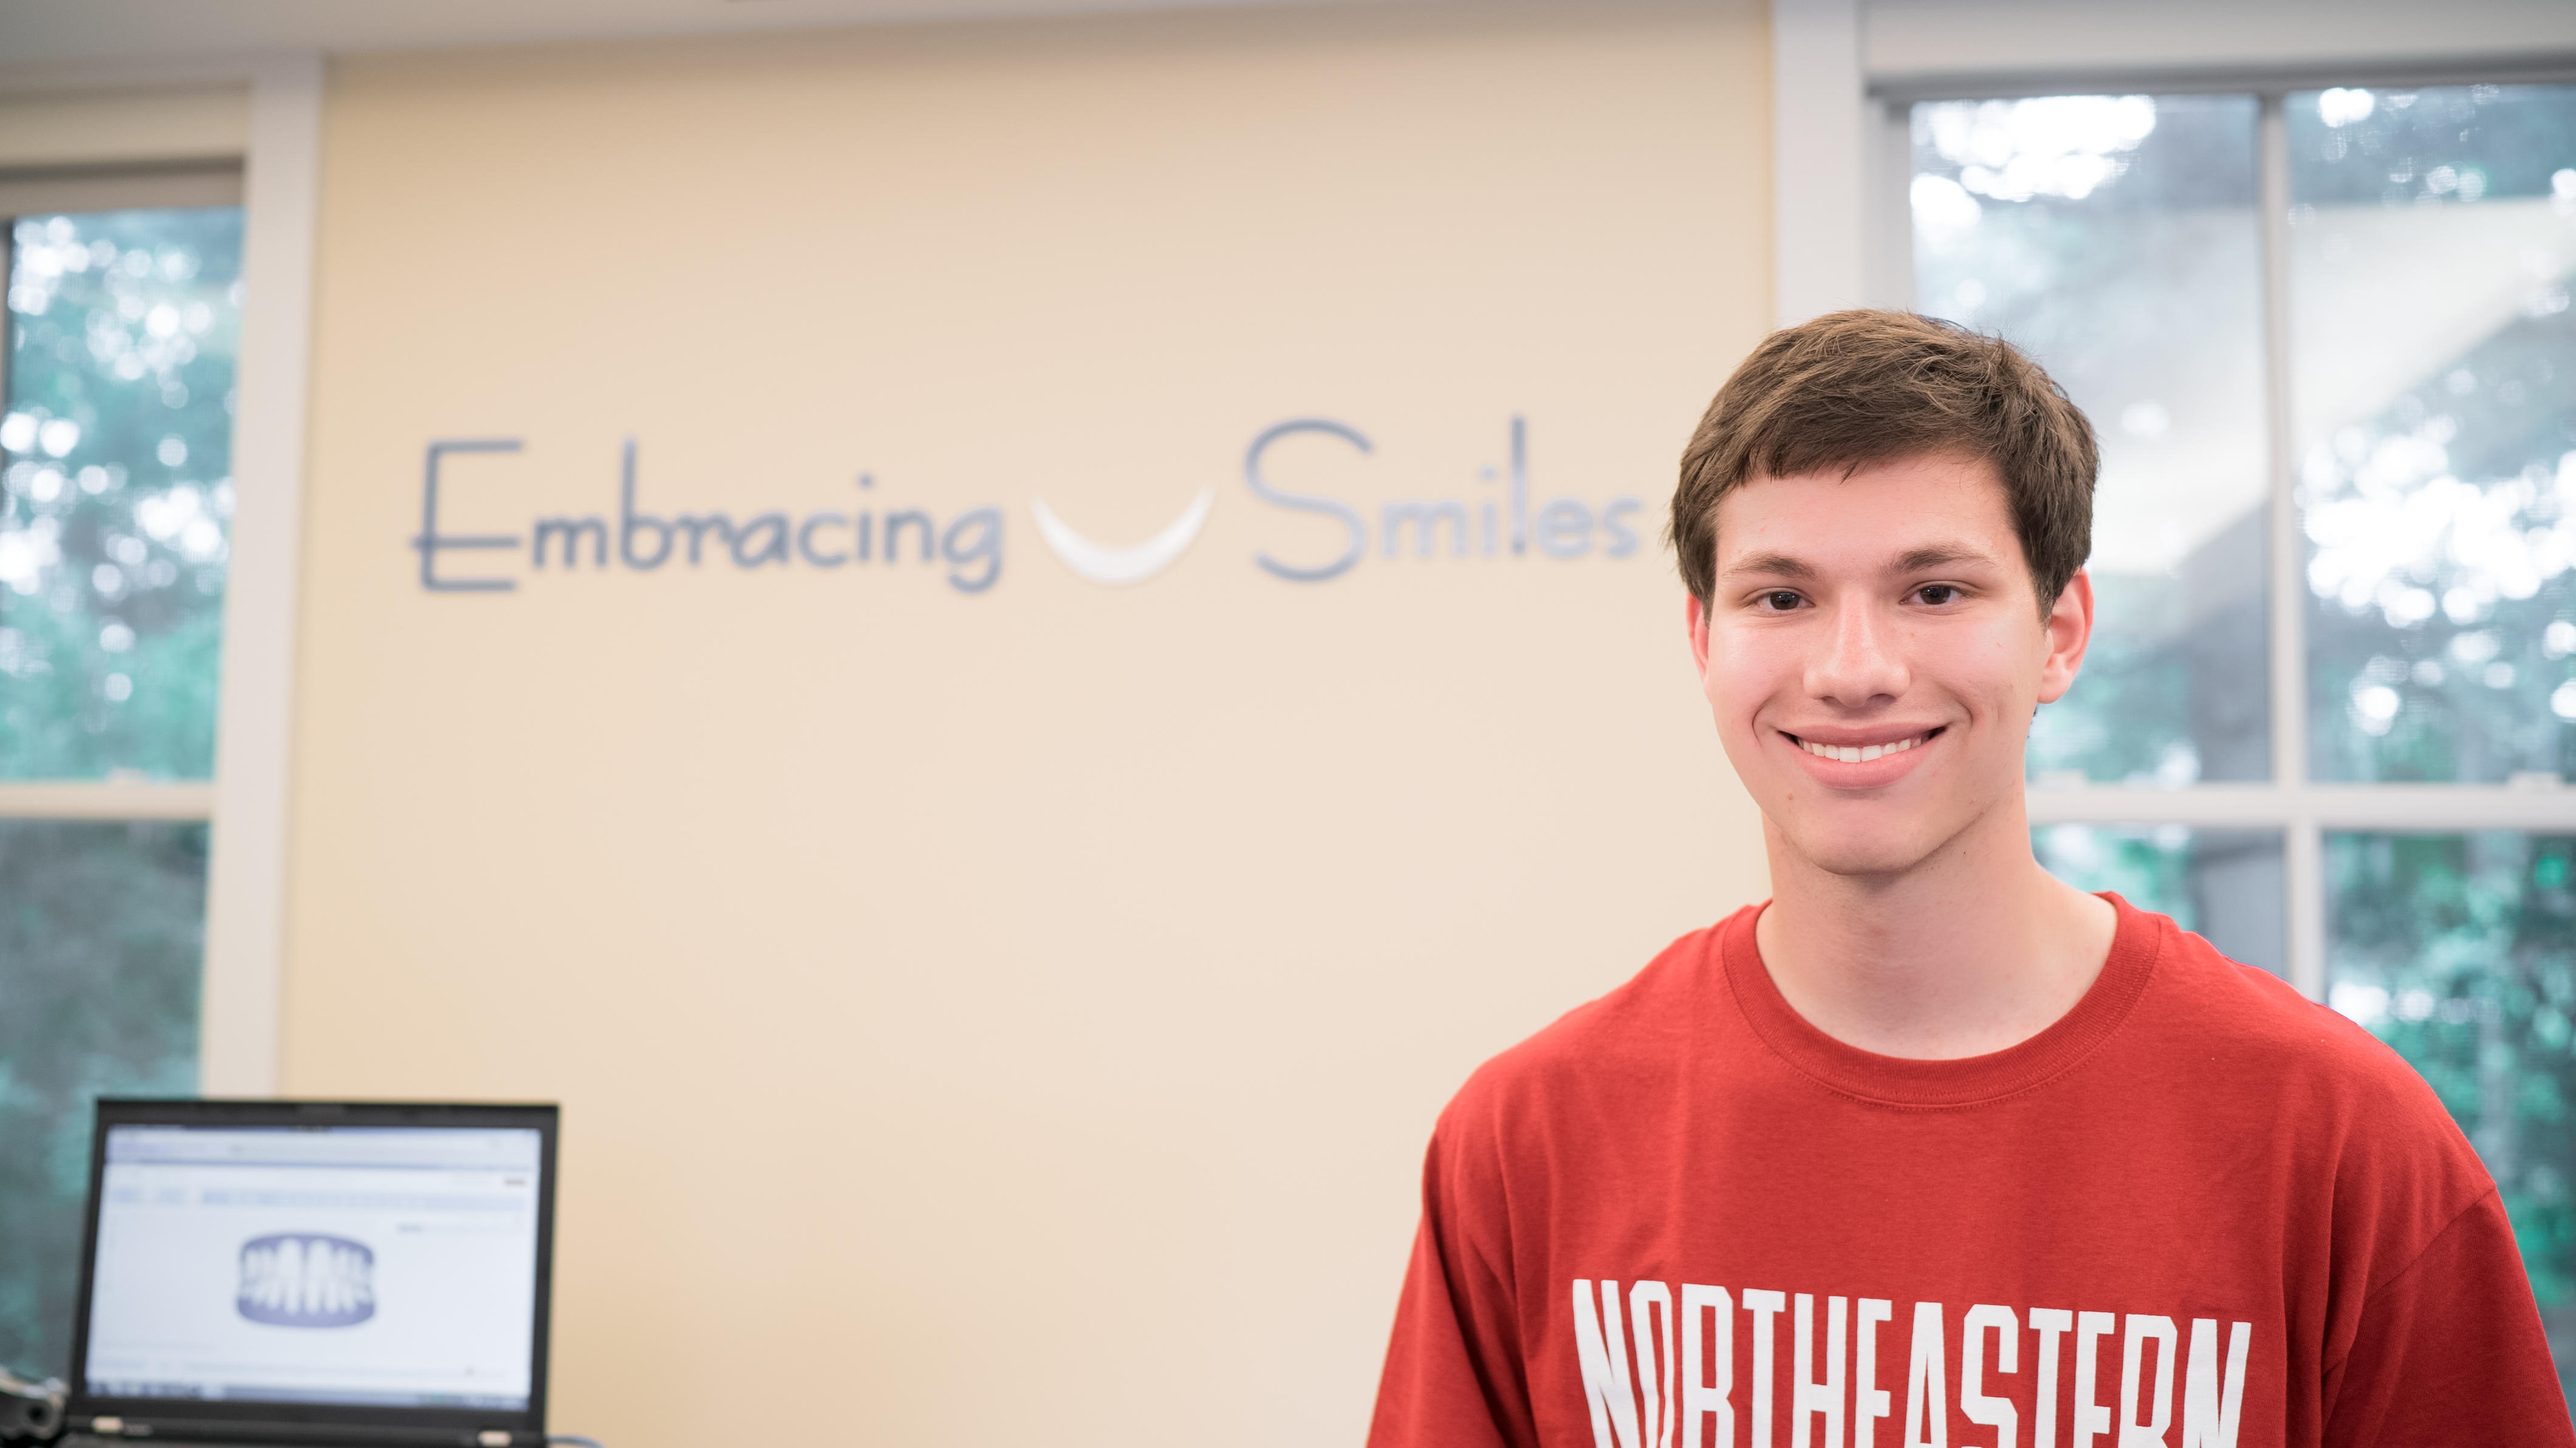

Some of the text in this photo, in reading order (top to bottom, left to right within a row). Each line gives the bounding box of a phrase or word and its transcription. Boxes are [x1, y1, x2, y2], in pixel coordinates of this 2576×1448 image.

[411, 414, 1644, 595] Embracing Smiles
[1572, 1278, 2252, 1448] NORTHEASTERN
